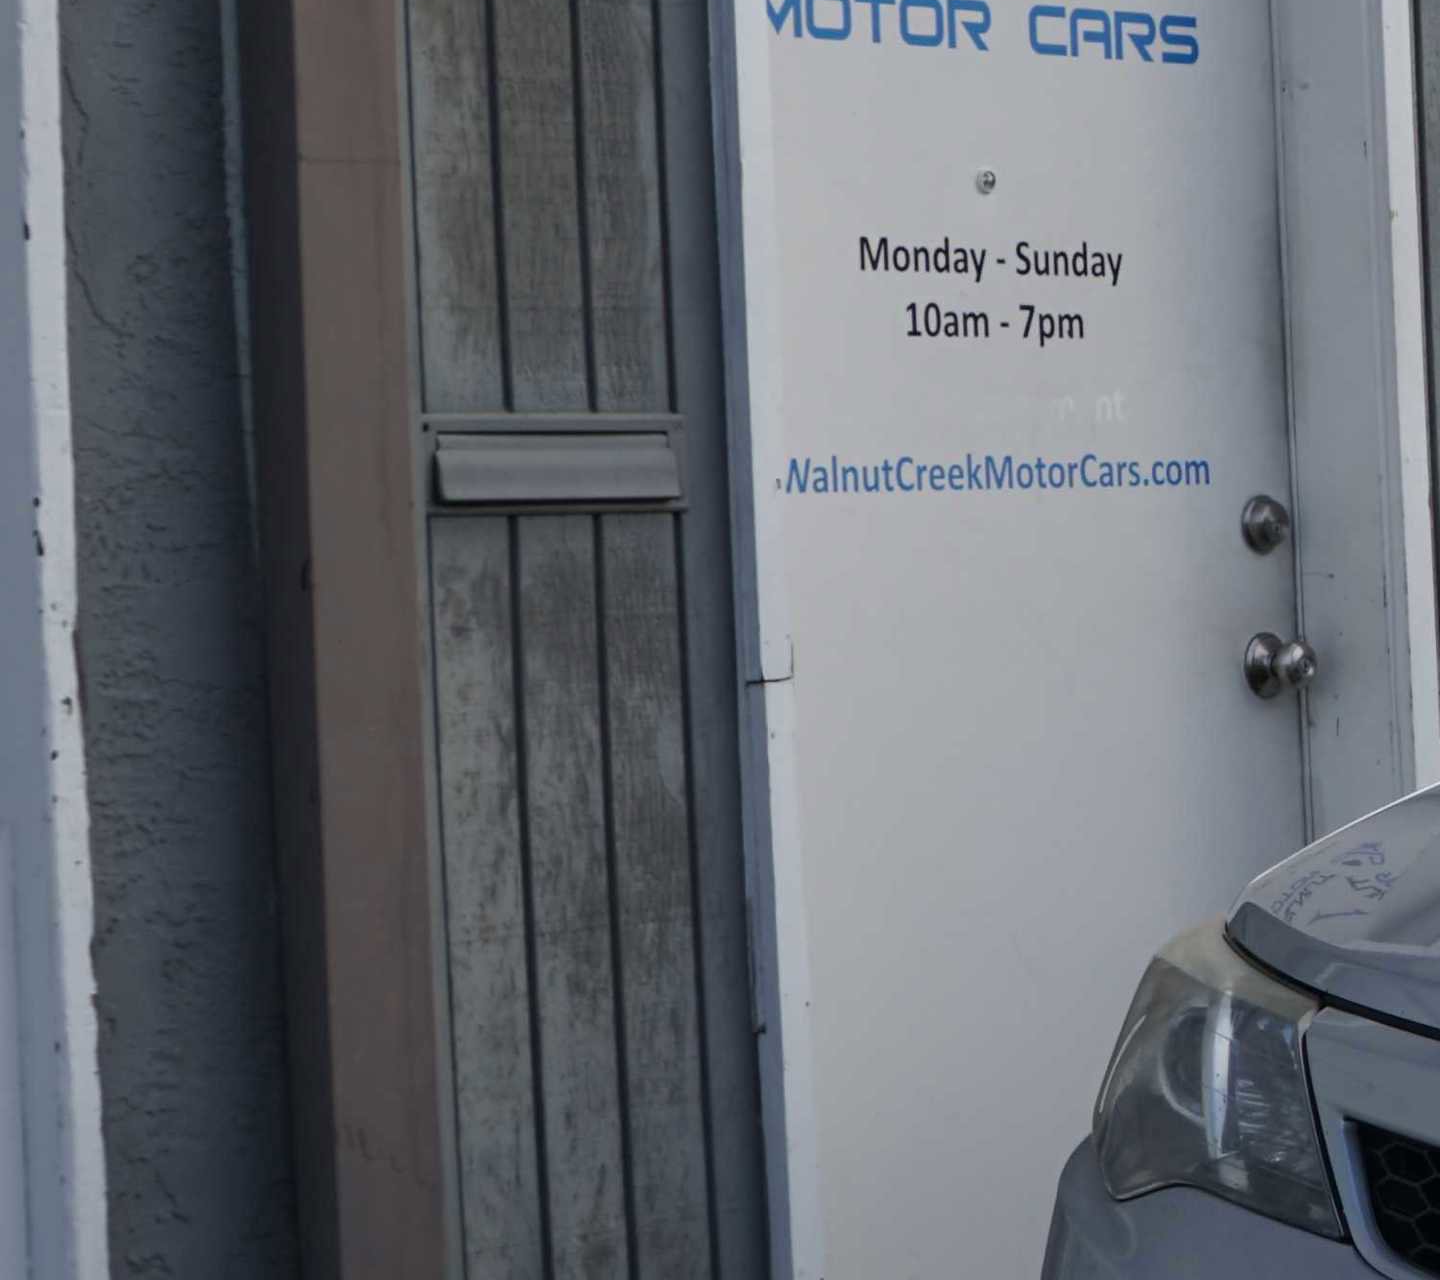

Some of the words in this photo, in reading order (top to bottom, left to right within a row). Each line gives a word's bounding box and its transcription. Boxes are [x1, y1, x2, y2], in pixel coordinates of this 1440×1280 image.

[1028, 5, 1199, 64] CARS
[859, 236, 986, 283] Monday
[1015, 241, 1122, 286] Sunday
[906, 302, 990, 337] 10am
[1019, 305, 1084, 347] 7pm
